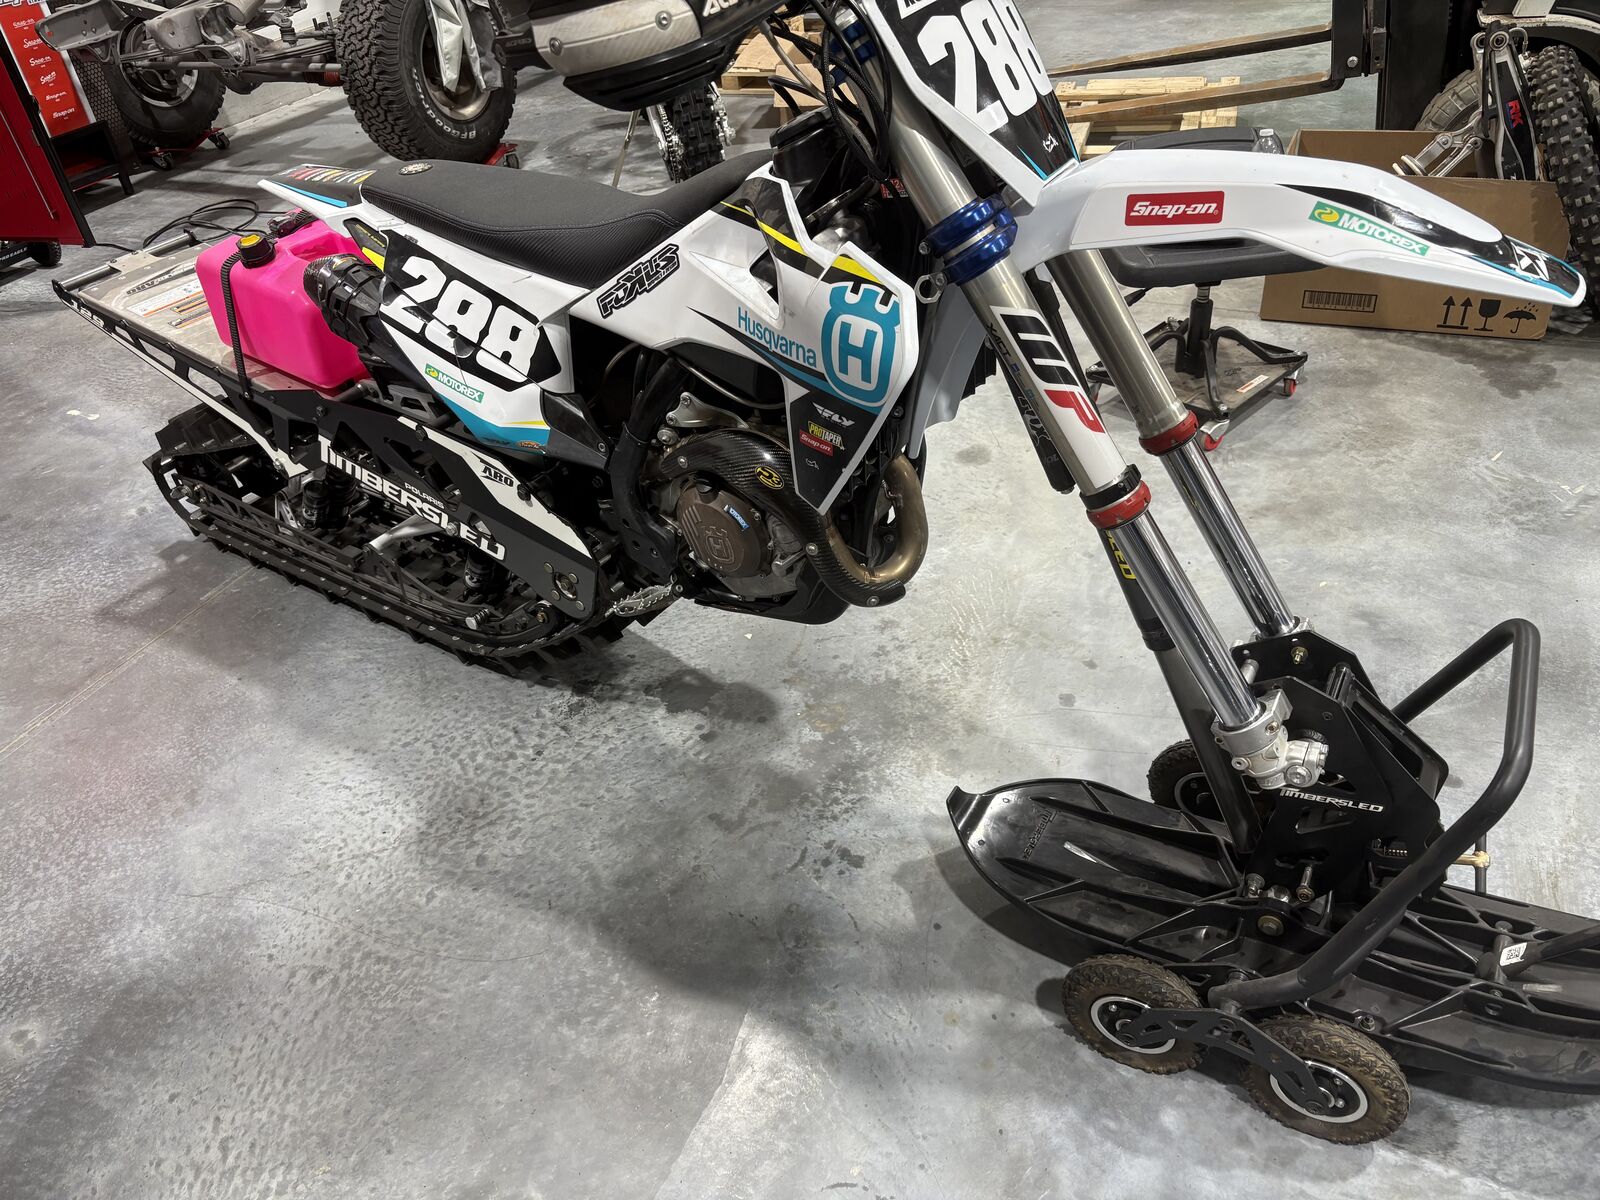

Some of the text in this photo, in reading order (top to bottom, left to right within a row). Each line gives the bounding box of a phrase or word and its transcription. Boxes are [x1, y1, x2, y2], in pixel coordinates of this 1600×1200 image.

[1337, 212, 1426, 255] MOTOREX
[381, 255, 541, 383] 288
[737, 306, 818, 368] Husqvarna
[437, 372, 483, 400] MOTOREX
[404, 482, 445, 510] POLARIS
